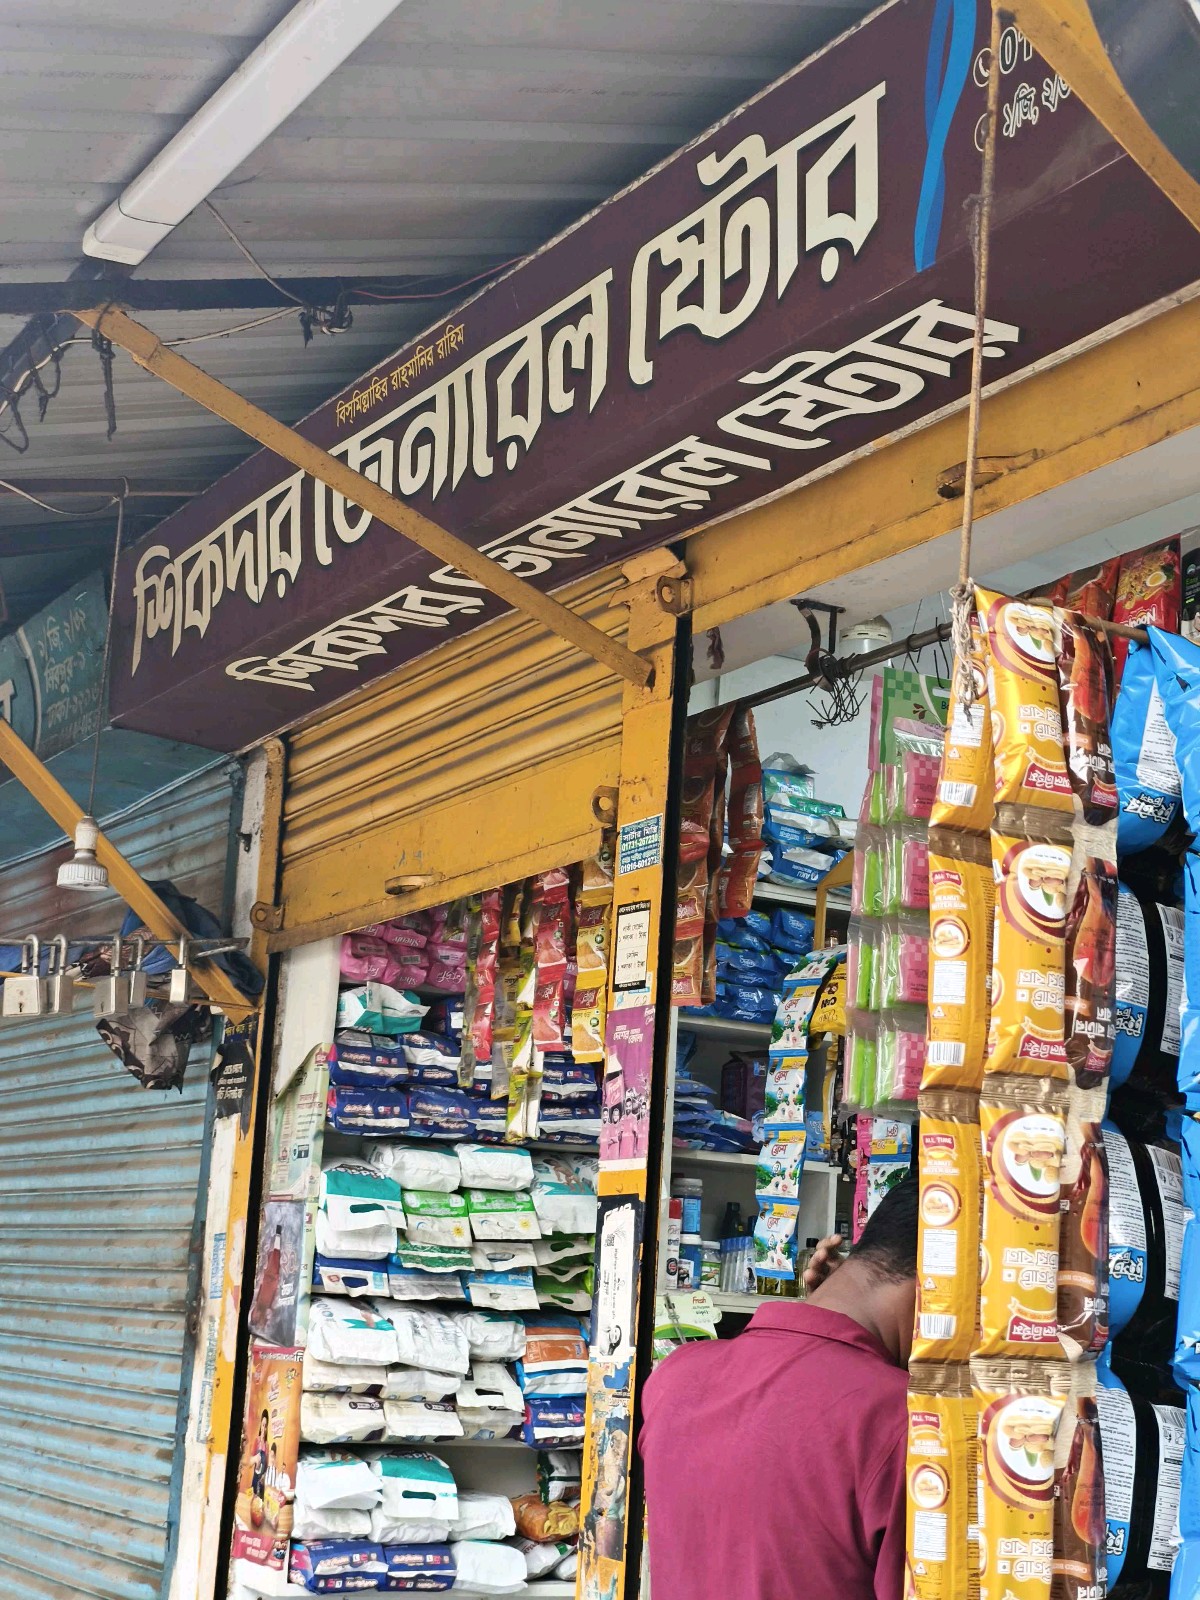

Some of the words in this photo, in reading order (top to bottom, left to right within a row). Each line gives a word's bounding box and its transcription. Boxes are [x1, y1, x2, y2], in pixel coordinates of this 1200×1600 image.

[435, 323, 465, 360] রাহিম
[131, 467, 305, 678] শিকদার
[314, 267, 613, 566] জেনারেল
[225, 585, 485, 693] শিকদার
